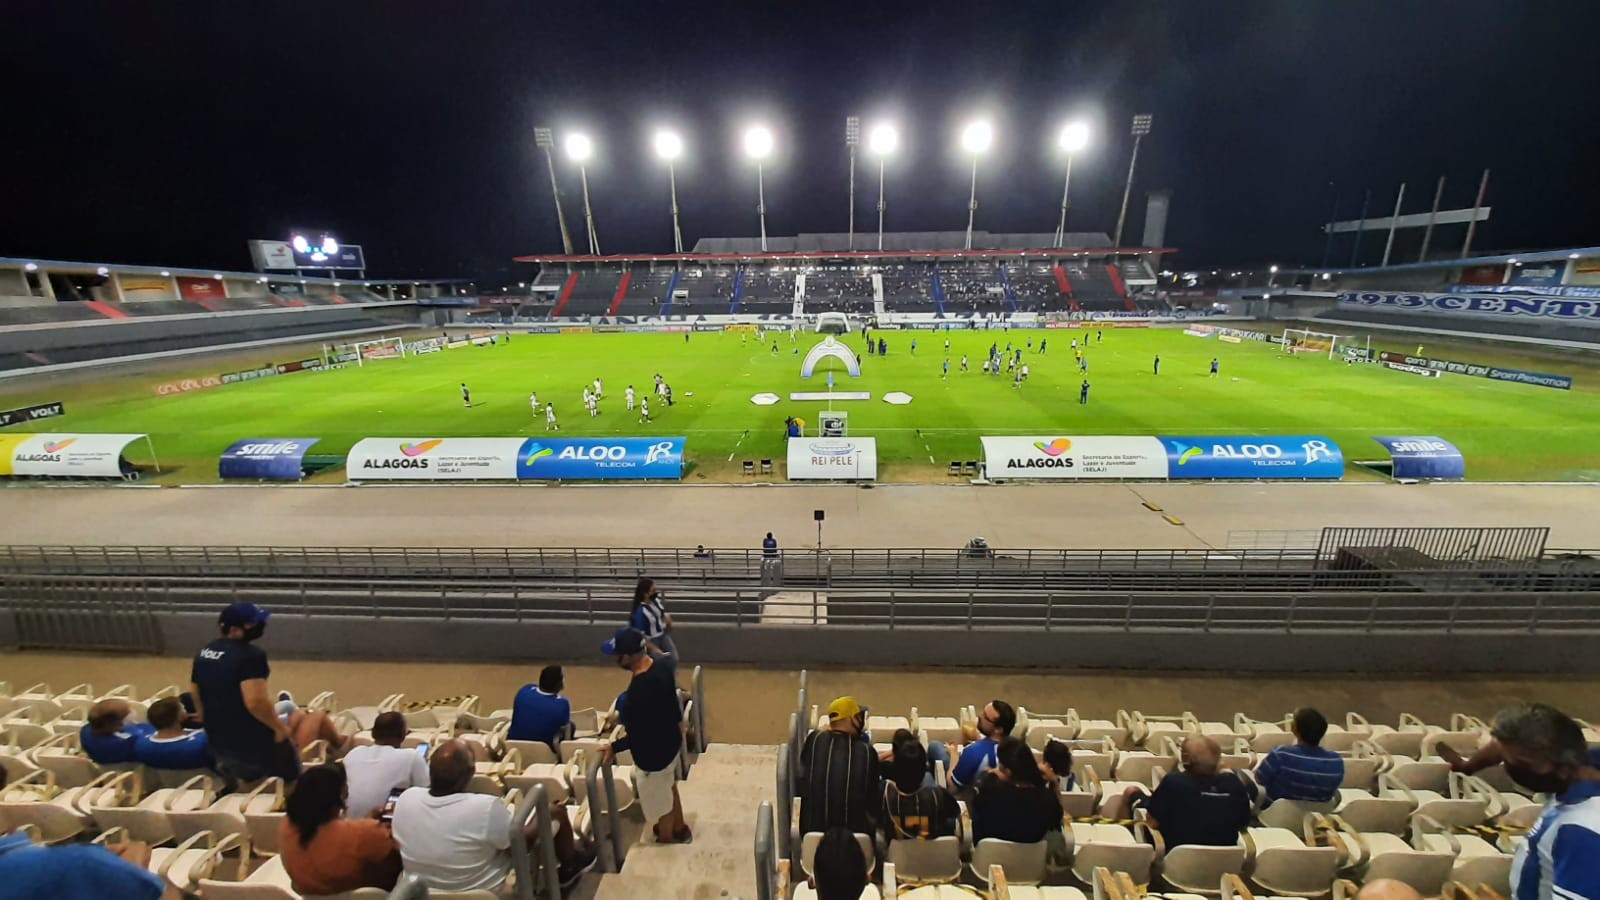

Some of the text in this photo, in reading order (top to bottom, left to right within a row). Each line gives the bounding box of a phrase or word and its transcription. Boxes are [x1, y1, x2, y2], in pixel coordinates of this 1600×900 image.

[1434, 297, 1600, 318] CENT
[30, 405, 60, 418] VOLT
[236, 441, 299, 455] smile
[1212, 444, 1283, 458] ALOO
[1391, 439, 1447, 452] smile
[15, 454, 62, 462] ALAGOAS
[558, 441, 674, 466] ALOO 18
[363, 458, 429, 469] ALAGOAS
[811, 456, 827, 465] REI
[1007, 458, 1074, 468] ALAGOAS
